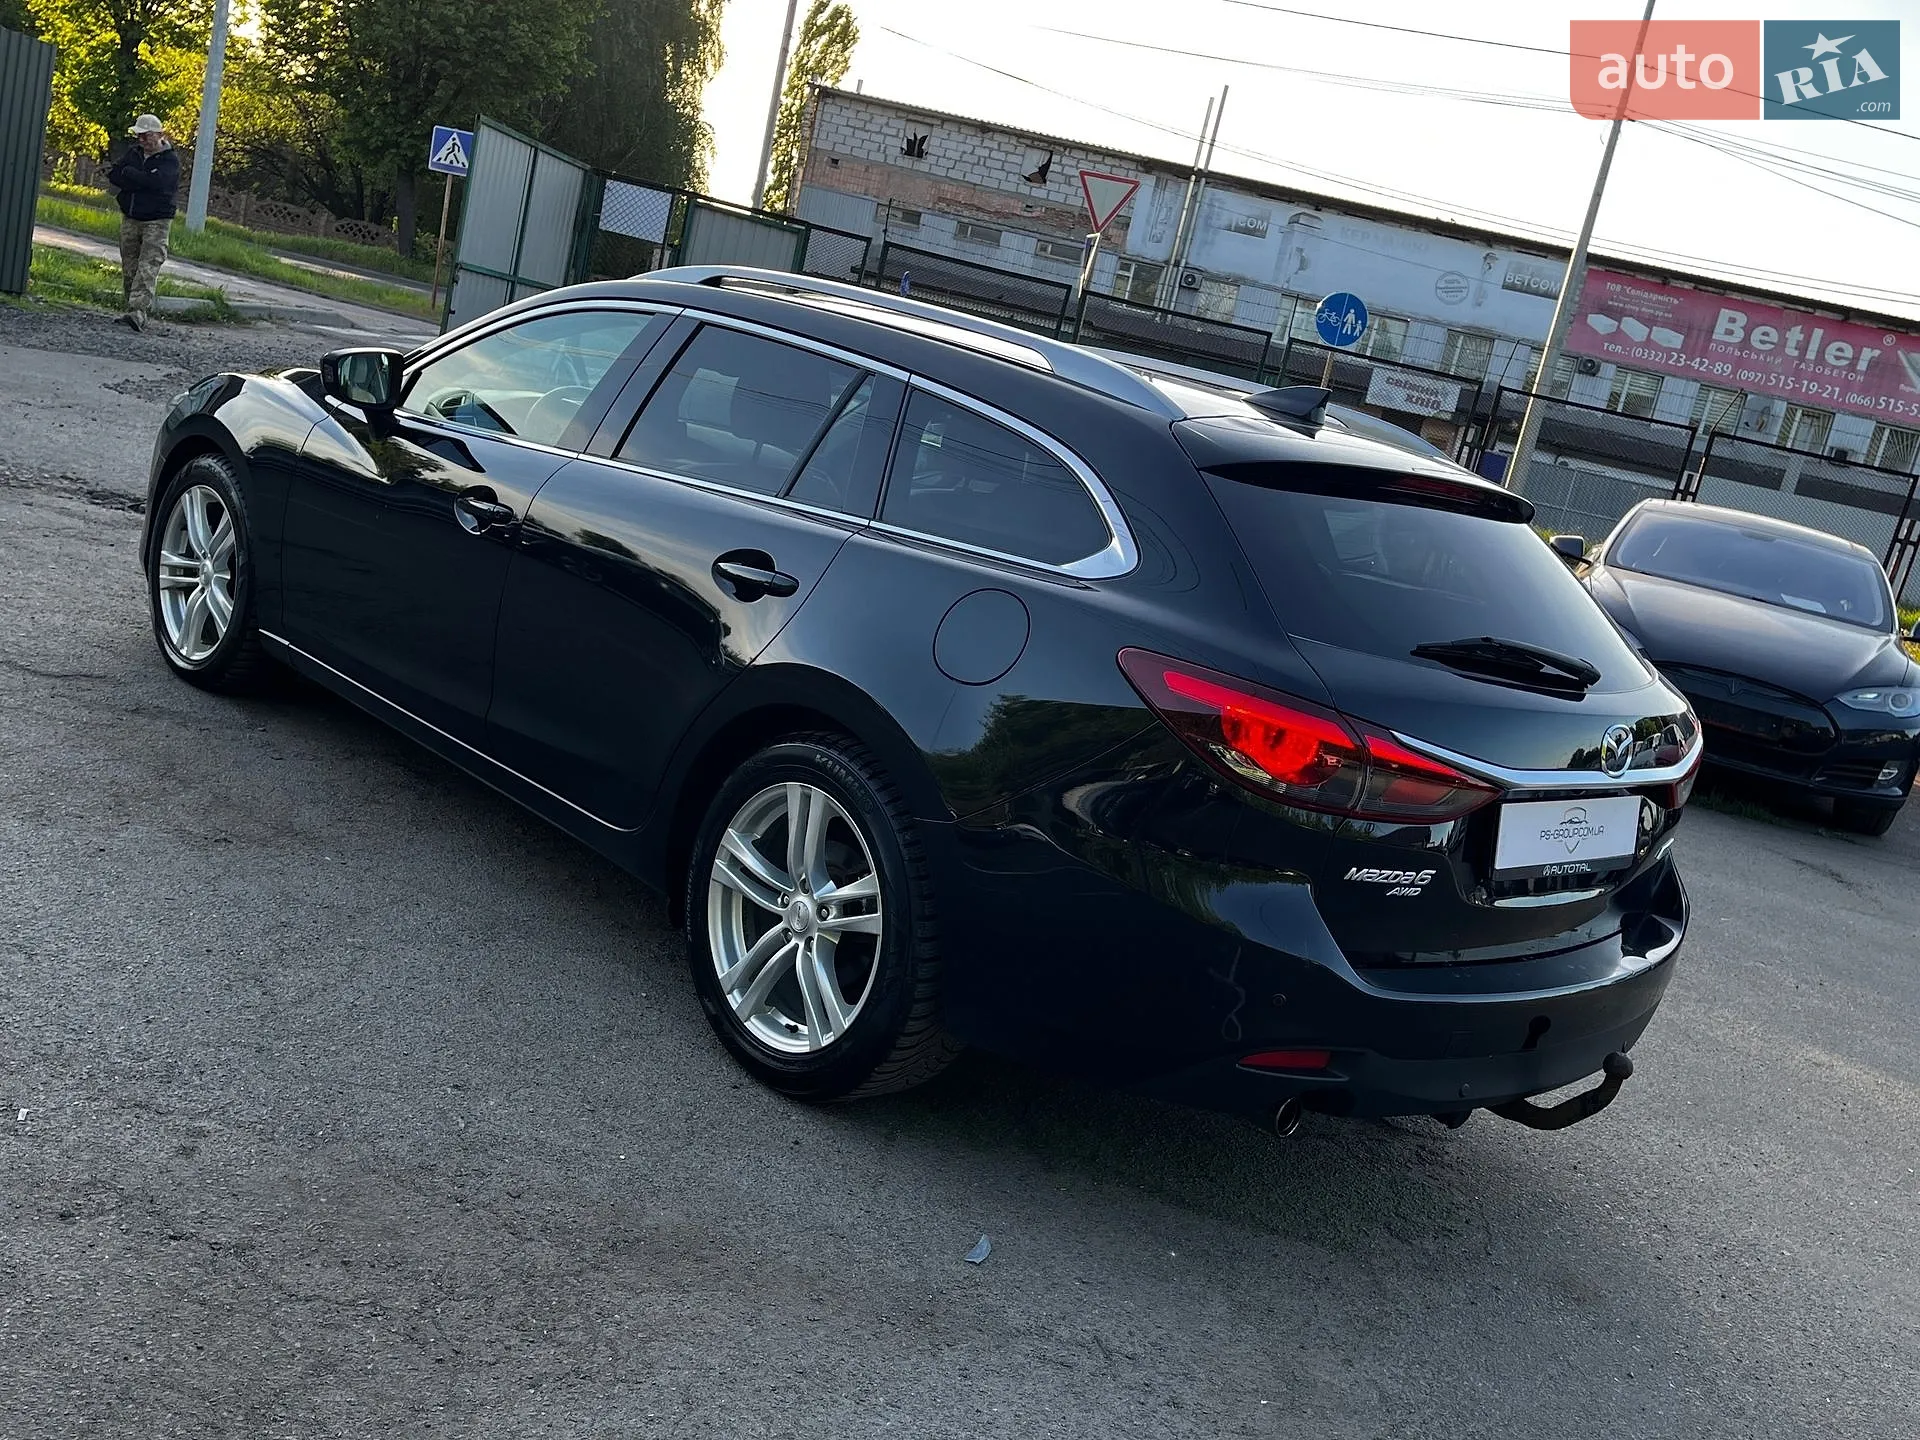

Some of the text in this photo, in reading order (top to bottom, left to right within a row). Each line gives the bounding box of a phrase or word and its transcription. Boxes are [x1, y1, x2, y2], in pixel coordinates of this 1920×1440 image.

[1711, 308, 1882, 372] Betler
[1603, 342, 1920, 417] тел.: (0332) 23-42-89, (097) 515-19-21, (066) 515-5
[1792, 361, 1865, 383] ГАЗОБЕТОН
[1550, 863, 1592, 875] AUTOTAL
[1386, 886, 1422, 896] AWD
